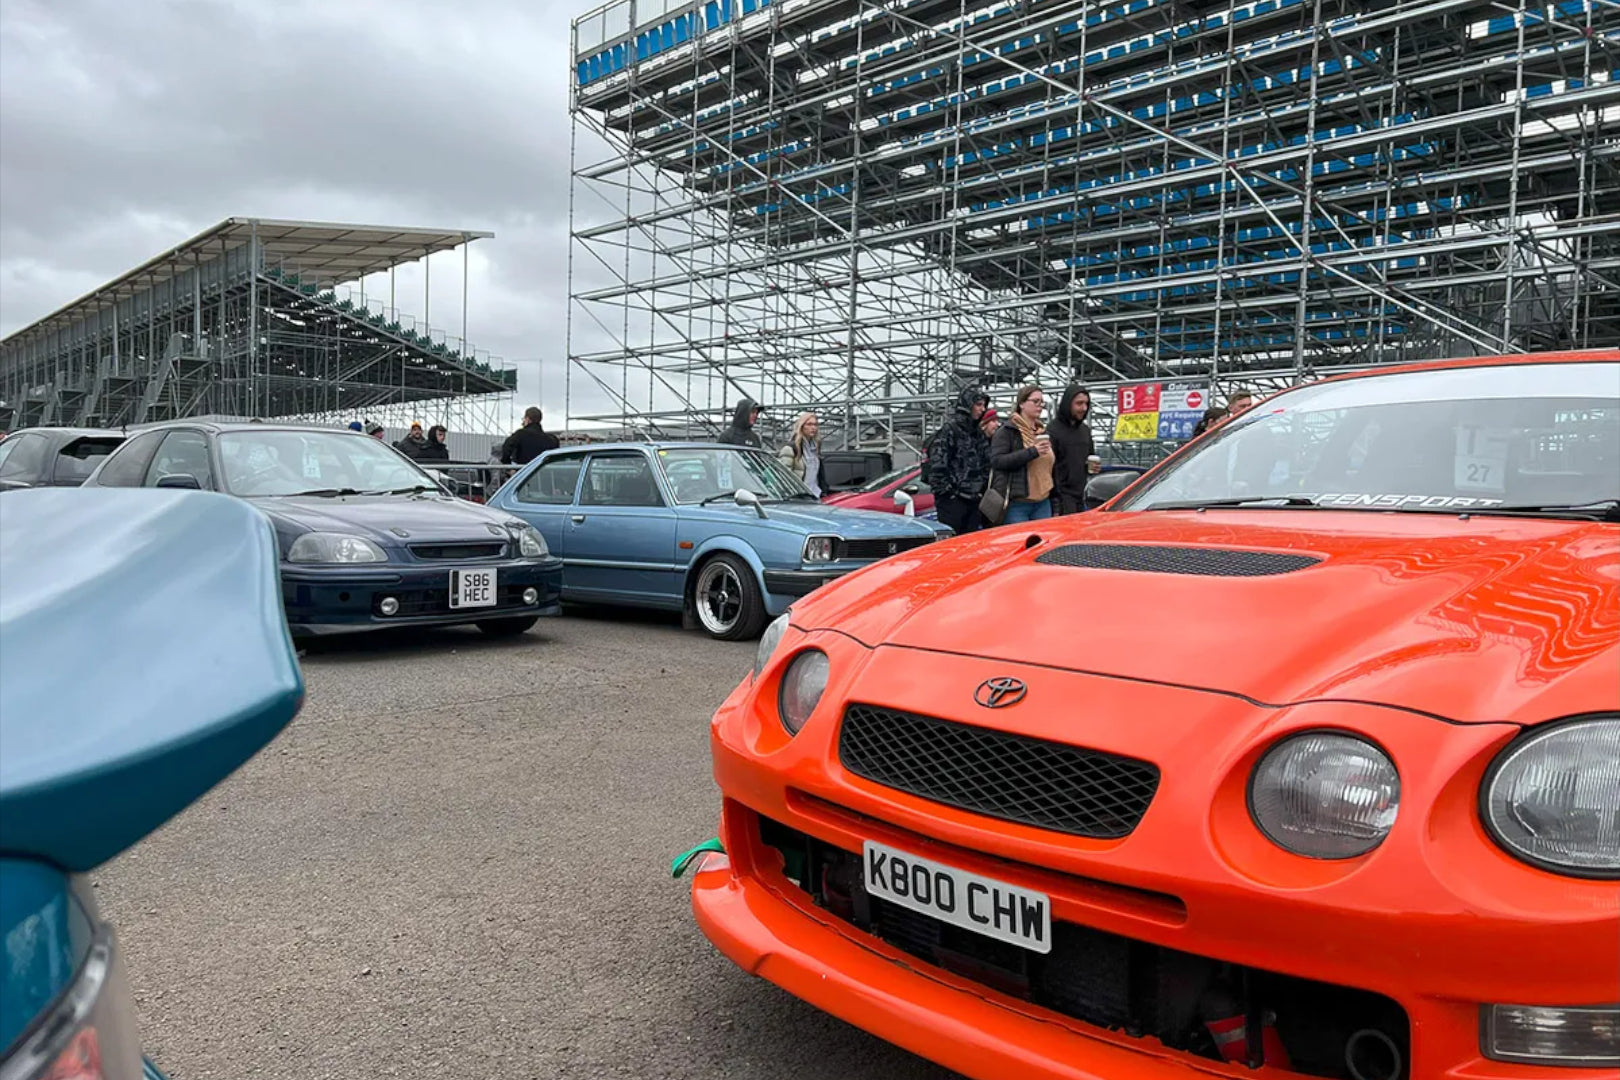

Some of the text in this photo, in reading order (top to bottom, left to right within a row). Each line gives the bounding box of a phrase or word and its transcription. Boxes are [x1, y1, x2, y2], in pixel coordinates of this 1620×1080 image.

[1123, 391, 1135, 409] B
[1467, 463, 1490, 482] 27
[464, 573, 489, 587] S86
[464, 588, 489, 602] HEC
[869, 848, 1043, 942] K800 CHW
